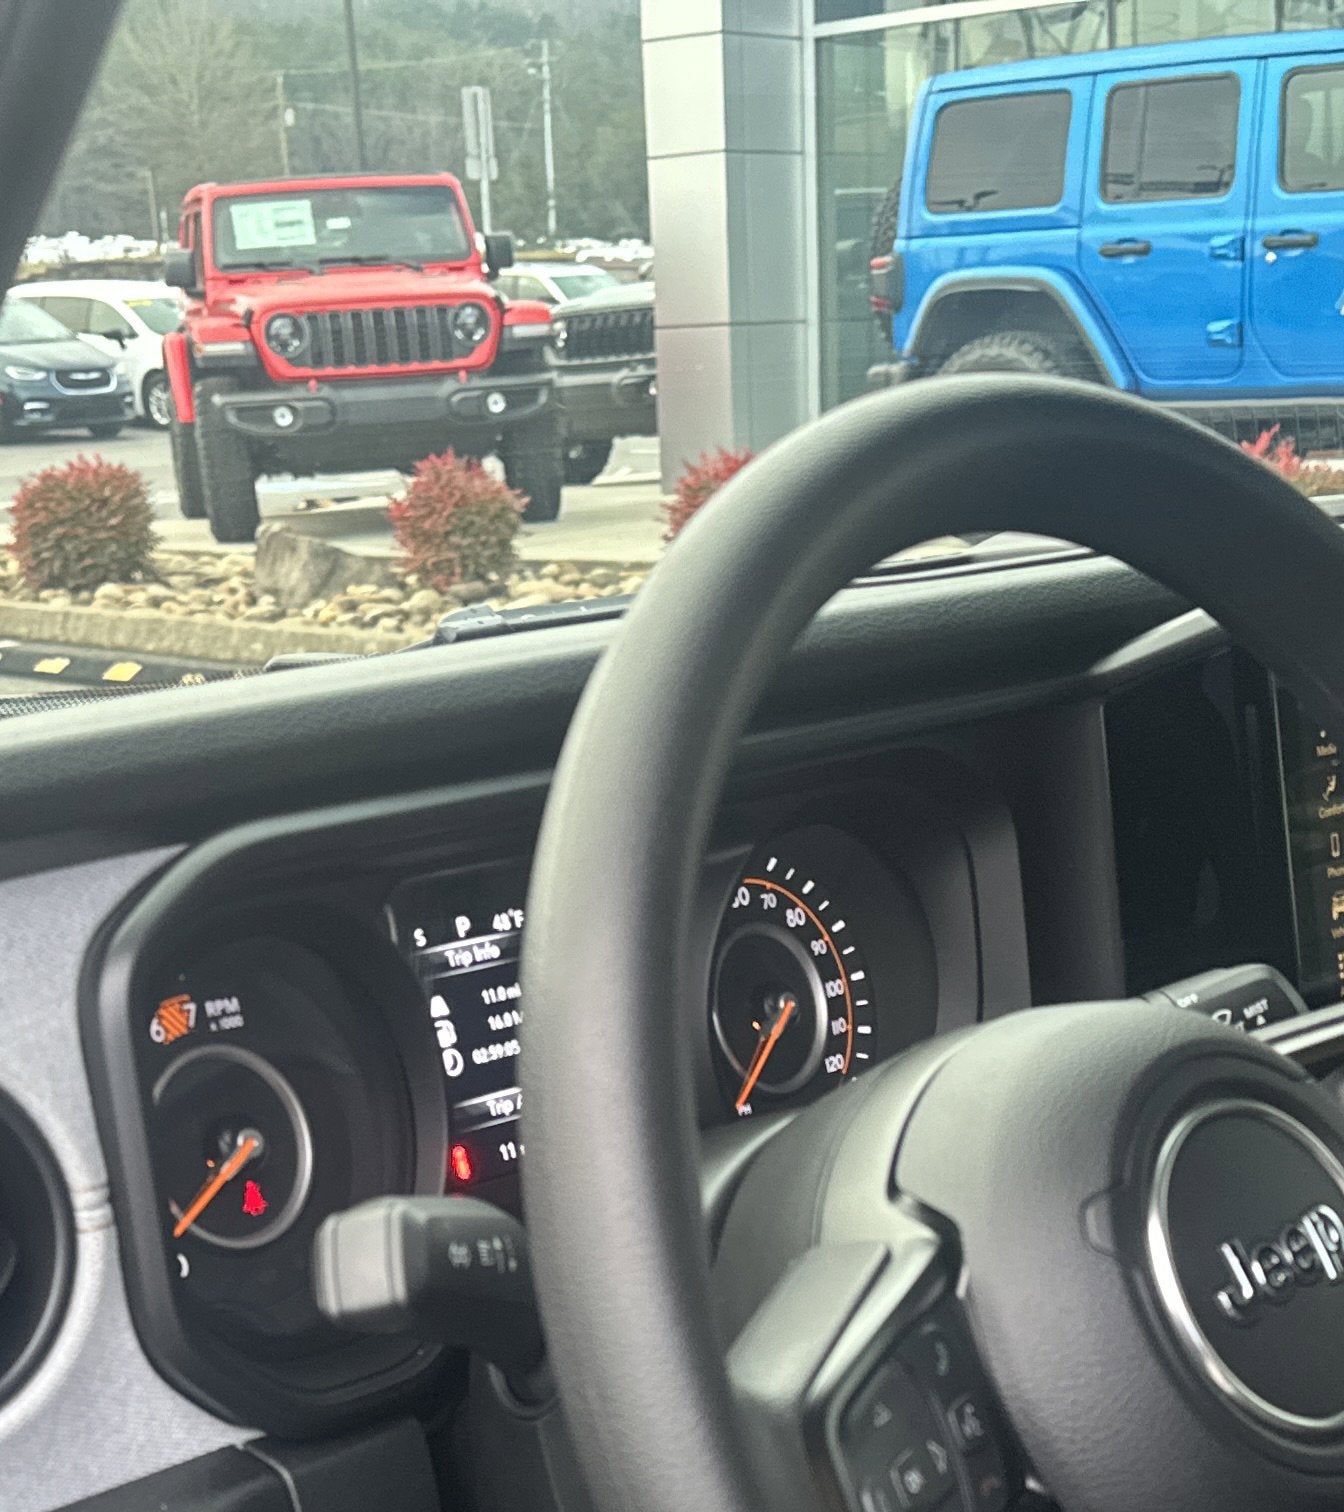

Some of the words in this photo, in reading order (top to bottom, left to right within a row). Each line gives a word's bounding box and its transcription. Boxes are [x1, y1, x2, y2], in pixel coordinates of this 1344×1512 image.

[455, 915, 471, 938] P
[786, 907, 806, 928] 80
[444, 949, 473, 968] Trip
[473, 941, 501, 962] Info
[486, 1098, 514, 1117] Trip
